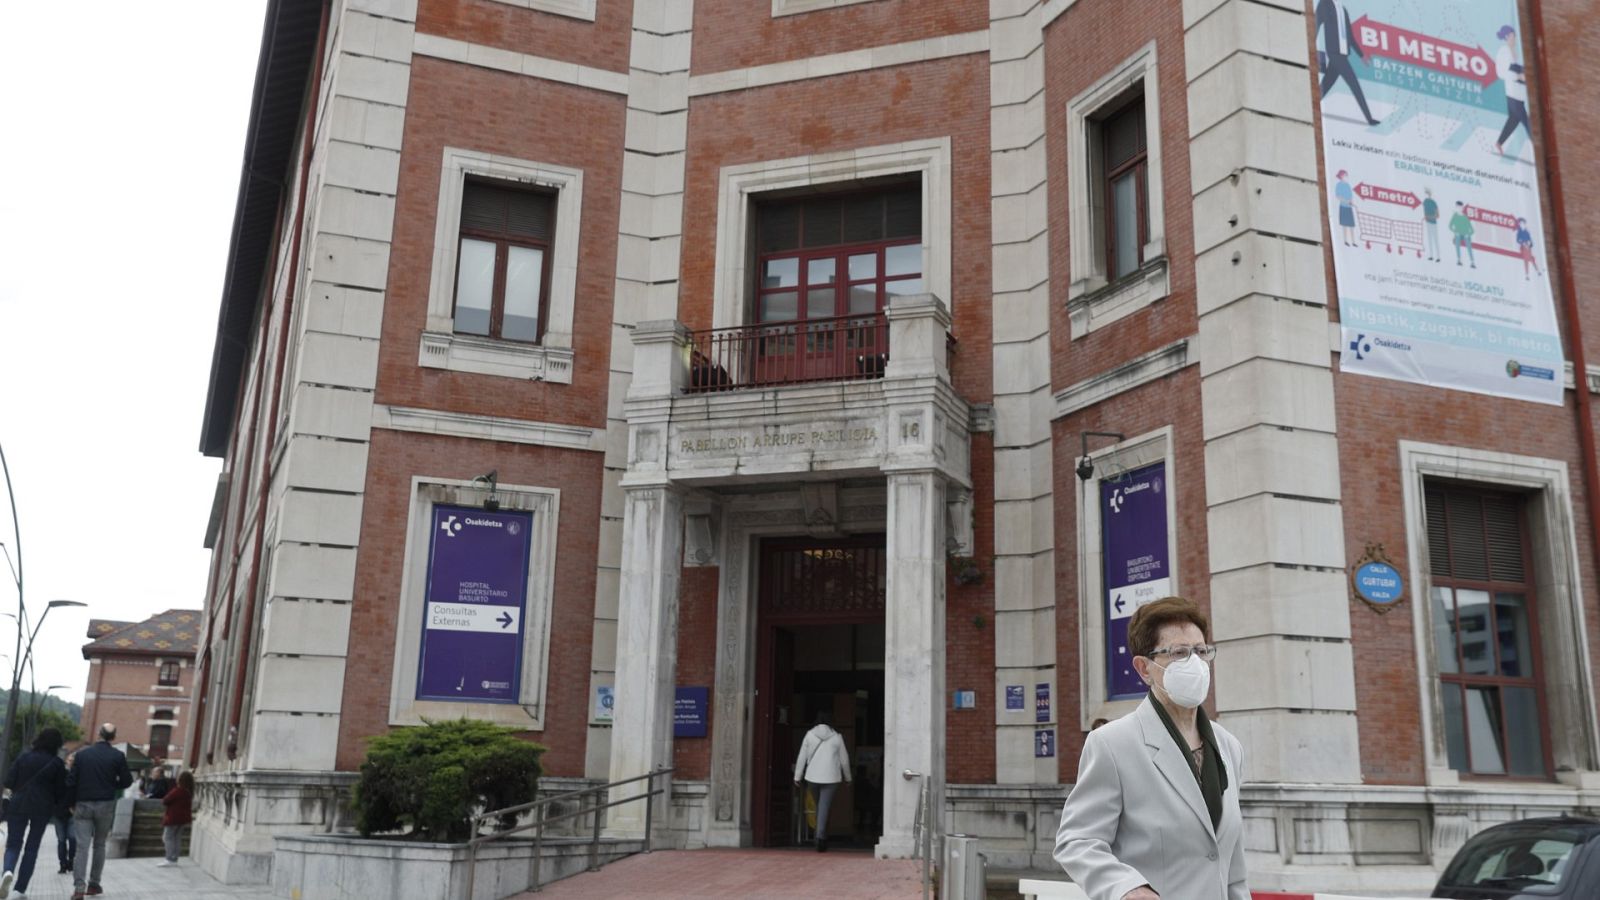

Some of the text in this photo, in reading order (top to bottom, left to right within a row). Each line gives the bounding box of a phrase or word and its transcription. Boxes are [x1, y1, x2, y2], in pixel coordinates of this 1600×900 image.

[1360, 26, 1488, 76] BI METRO
[1373, 58, 1482, 93] BATZEN GAITUEN
[1374, 70, 1483, 104] DISTANTZIA
[1394, 160, 1482, 188] ERABILI MASKARA
[1360, 185, 1416, 205] Bi metro
[1466, 207, 1516, 227] Bi metro
[1463, 281, 1505, 296] ISOLATU
[1374, 337, 1411, 351] Osakidetza
[1488, 329, 1502, 344] bi
[902, 422, 920, 438] 16
[753, 432, 805, 448] ARRUPE
[465, 517, 503, 528] Osakidetza
[458, 588, 508, 597] UNIVERSITARIO
[459, 581, 490, 589] HOSPITAL
[458, 595, 489, 603] BASURTO
[433, 605, 478, 616] Consultas
[433, 616, 471, 626] Externas
